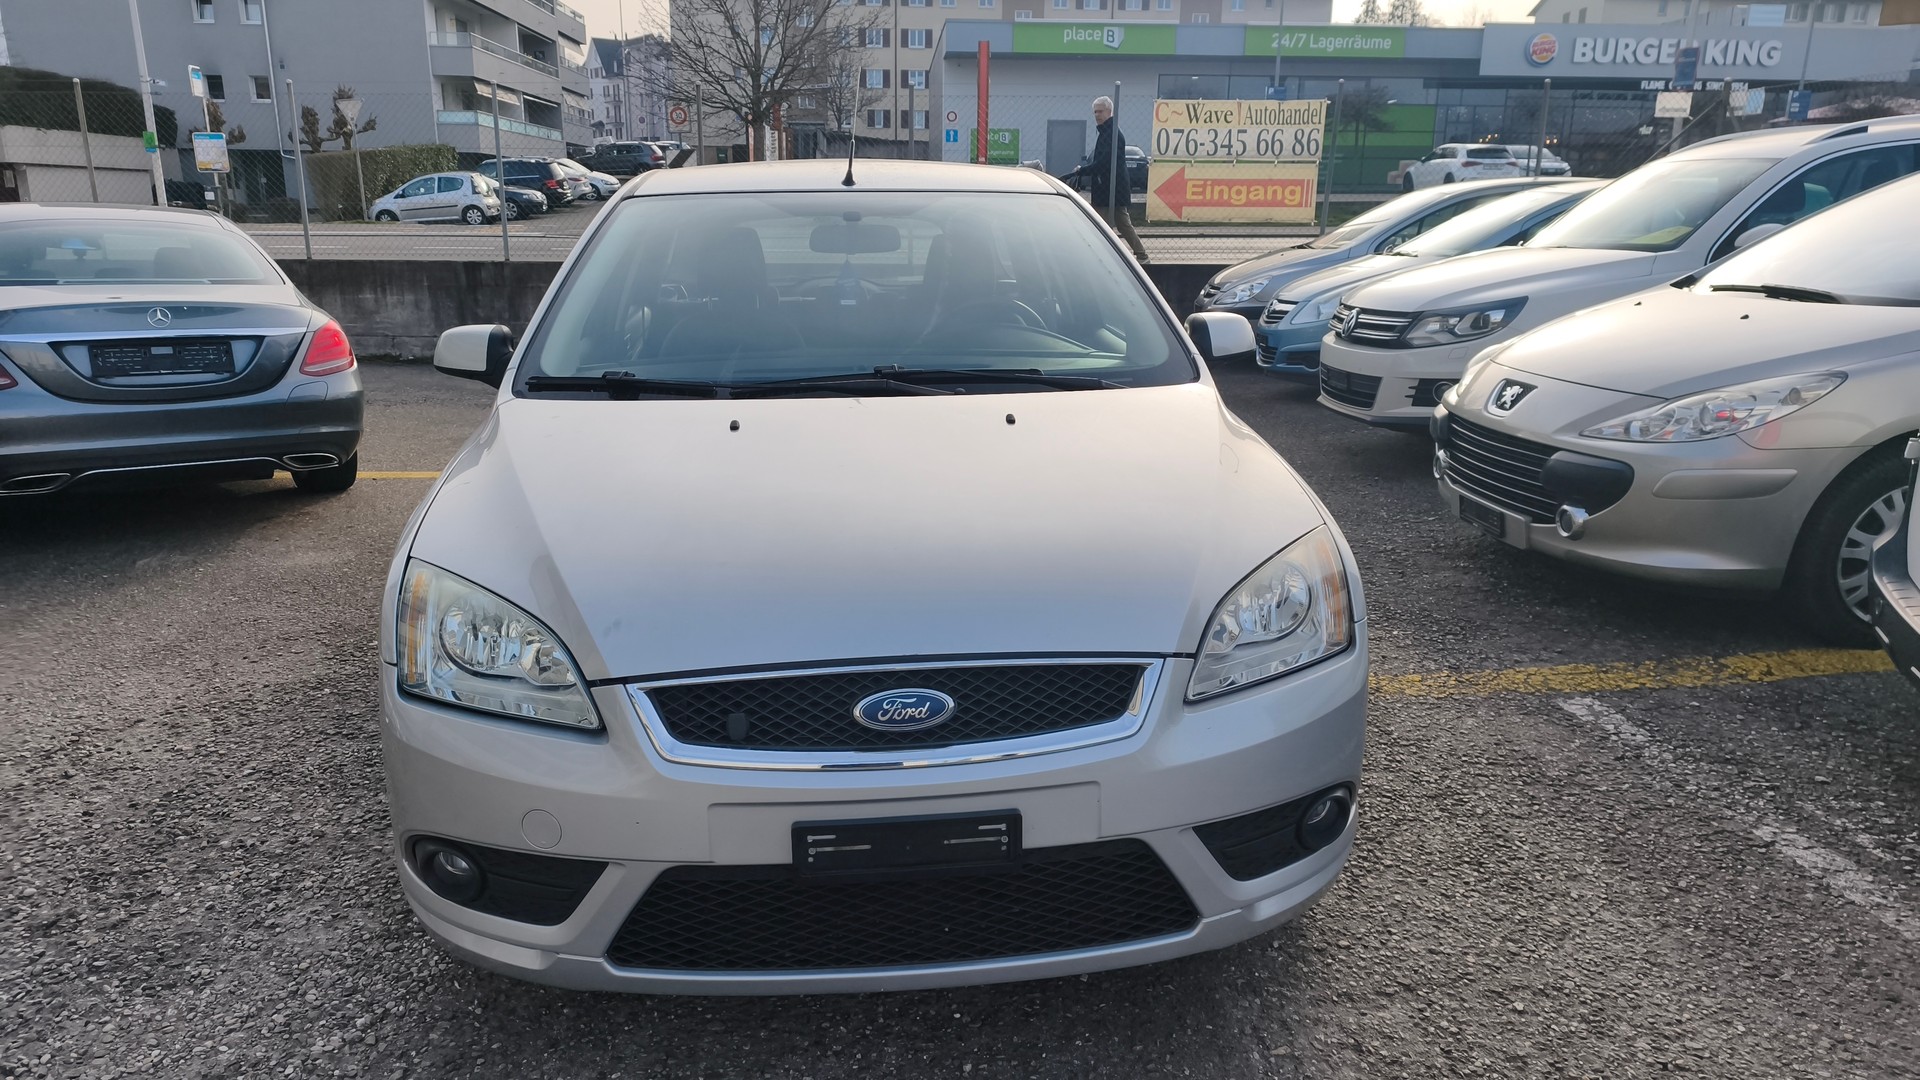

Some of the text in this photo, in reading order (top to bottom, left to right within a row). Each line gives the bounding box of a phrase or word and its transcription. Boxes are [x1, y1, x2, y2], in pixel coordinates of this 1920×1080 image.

[1063, 26, 1101, 43] place
[1271, 33, 1392, 52] 24/7 Lagerräume
[1573, 37, 1783, 67] BURGE KING
[1641, 80, 1666, 90] FLAME
[1243, 101, 1323, 126] Autohandel
[1156, 127, 1320, 157] 076-345 66 86
[1185, 180, 1302, 206] Eingang
[877, 697, 930, 721] Ford
